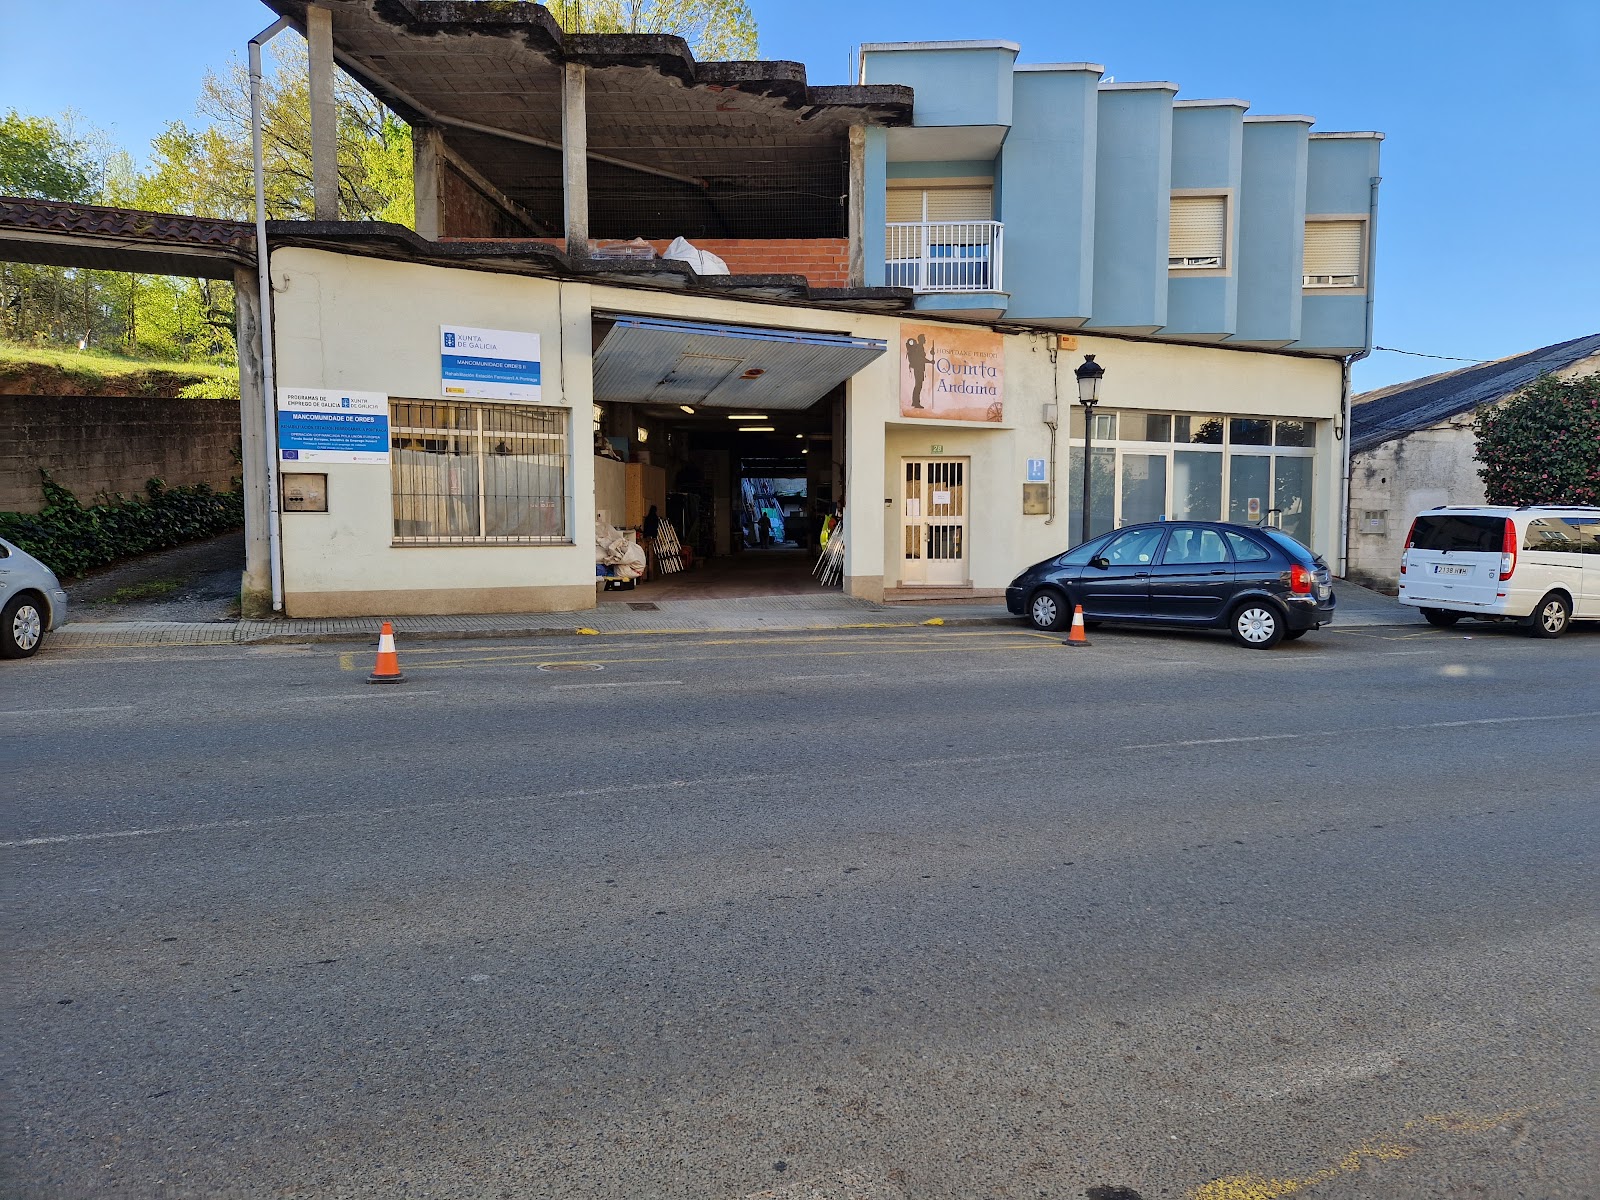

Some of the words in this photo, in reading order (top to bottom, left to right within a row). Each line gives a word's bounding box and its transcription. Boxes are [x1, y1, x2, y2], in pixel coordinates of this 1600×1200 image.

[457, 334, 482, 342] XUNTA
[469, 342, 498, 350] GALICIA
[936, 348, 972, 357] HOSPEDAXE
[457, 359, 503, 368] MANCOMUNIDADE
[936, 358, 997, 379] Quinta
[937, 378, 997, 396] Andaina
[287, 394, 319, 402] PROGRAMAS
[292, 413, 345, 422] MANCOMUNIDADE
[1033, 460, 1042, 472] P
